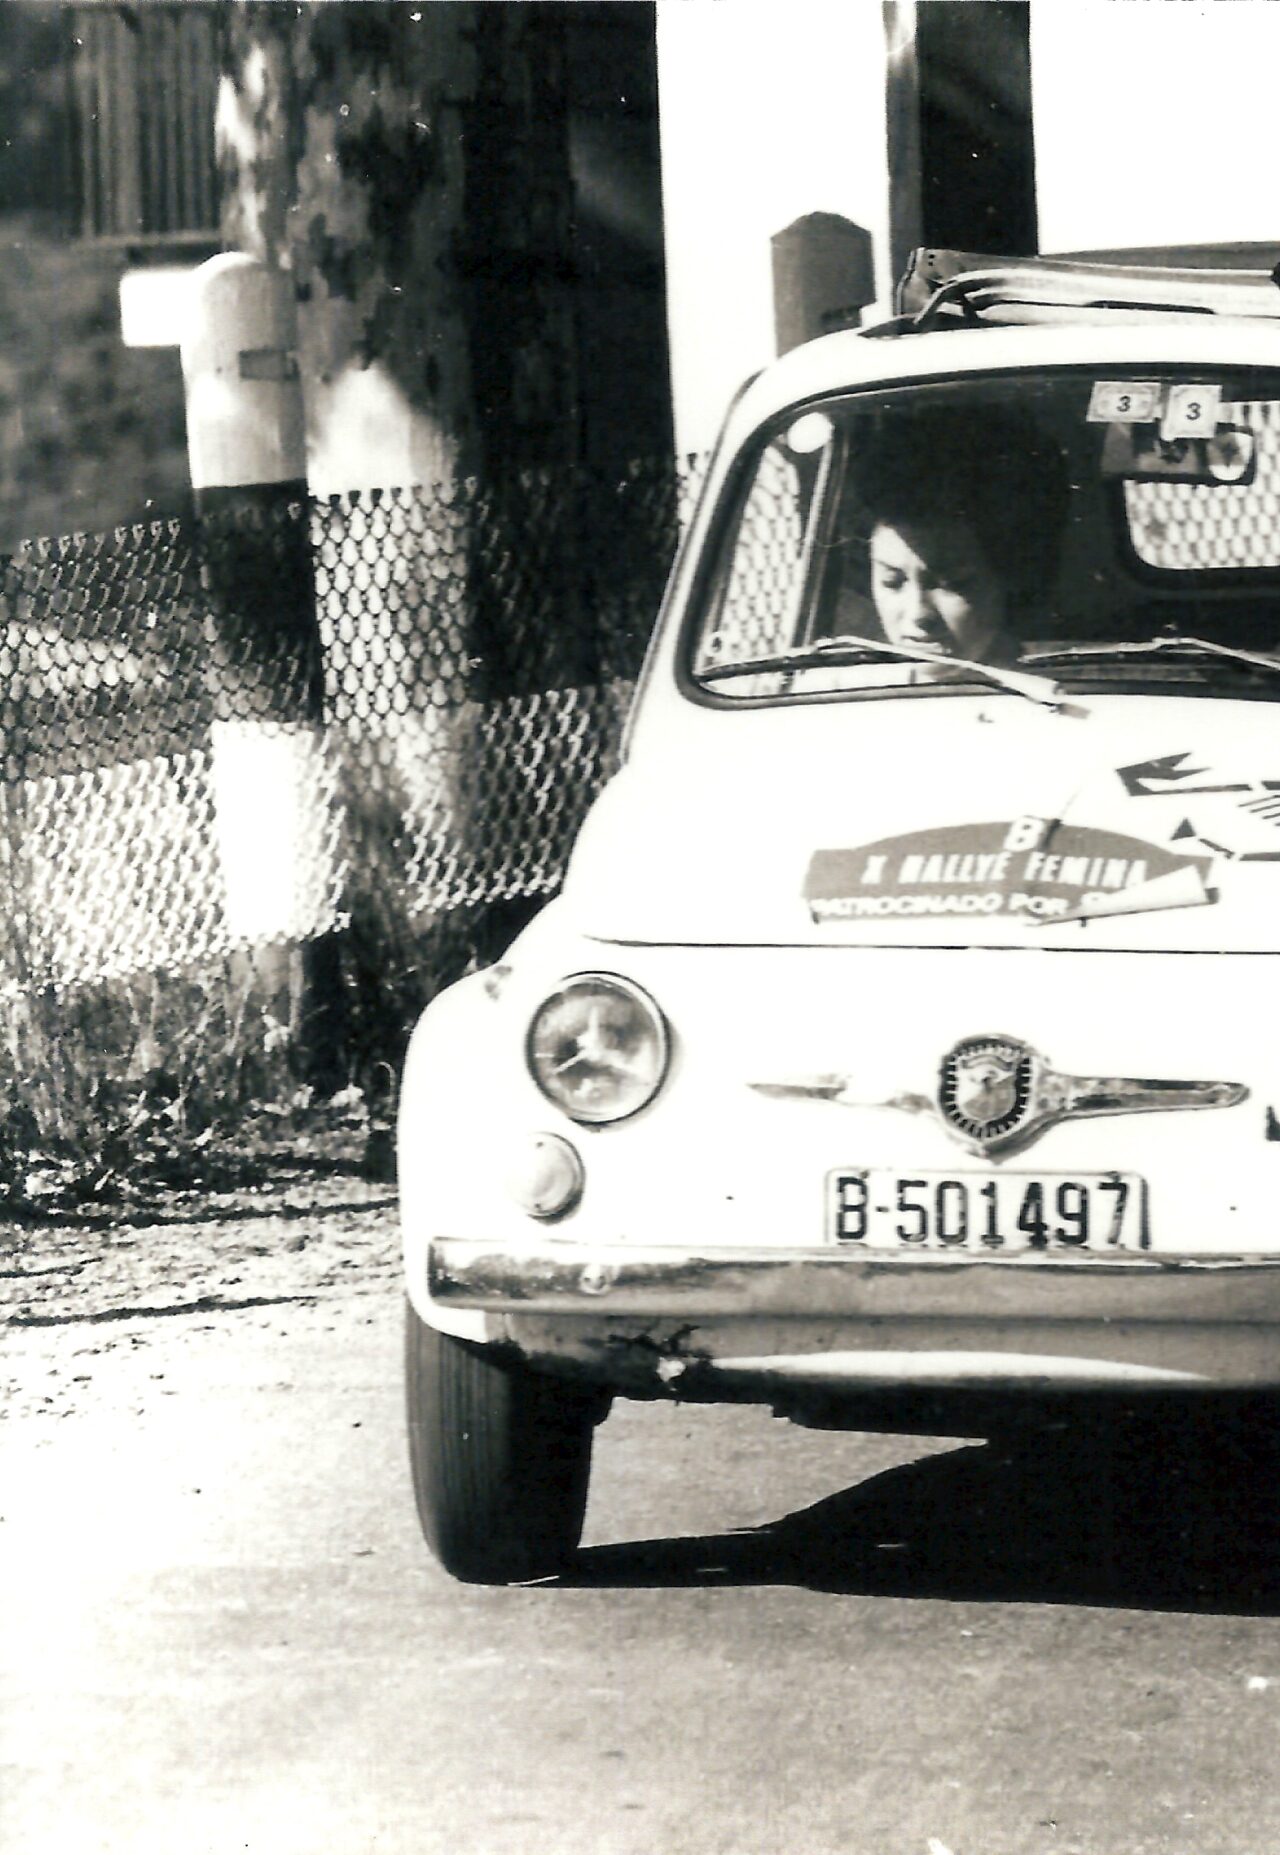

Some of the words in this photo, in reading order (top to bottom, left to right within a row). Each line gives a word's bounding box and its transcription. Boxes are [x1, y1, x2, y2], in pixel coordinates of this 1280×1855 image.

[1116, 395, 1131, 412] 3
[1186, 402, 1201, 420] 3
[898, 852, 1012, 884] RALLYE
[1009, 892, 1069, 915] POR
[836, 1176, 1129, 1247] B-501497
